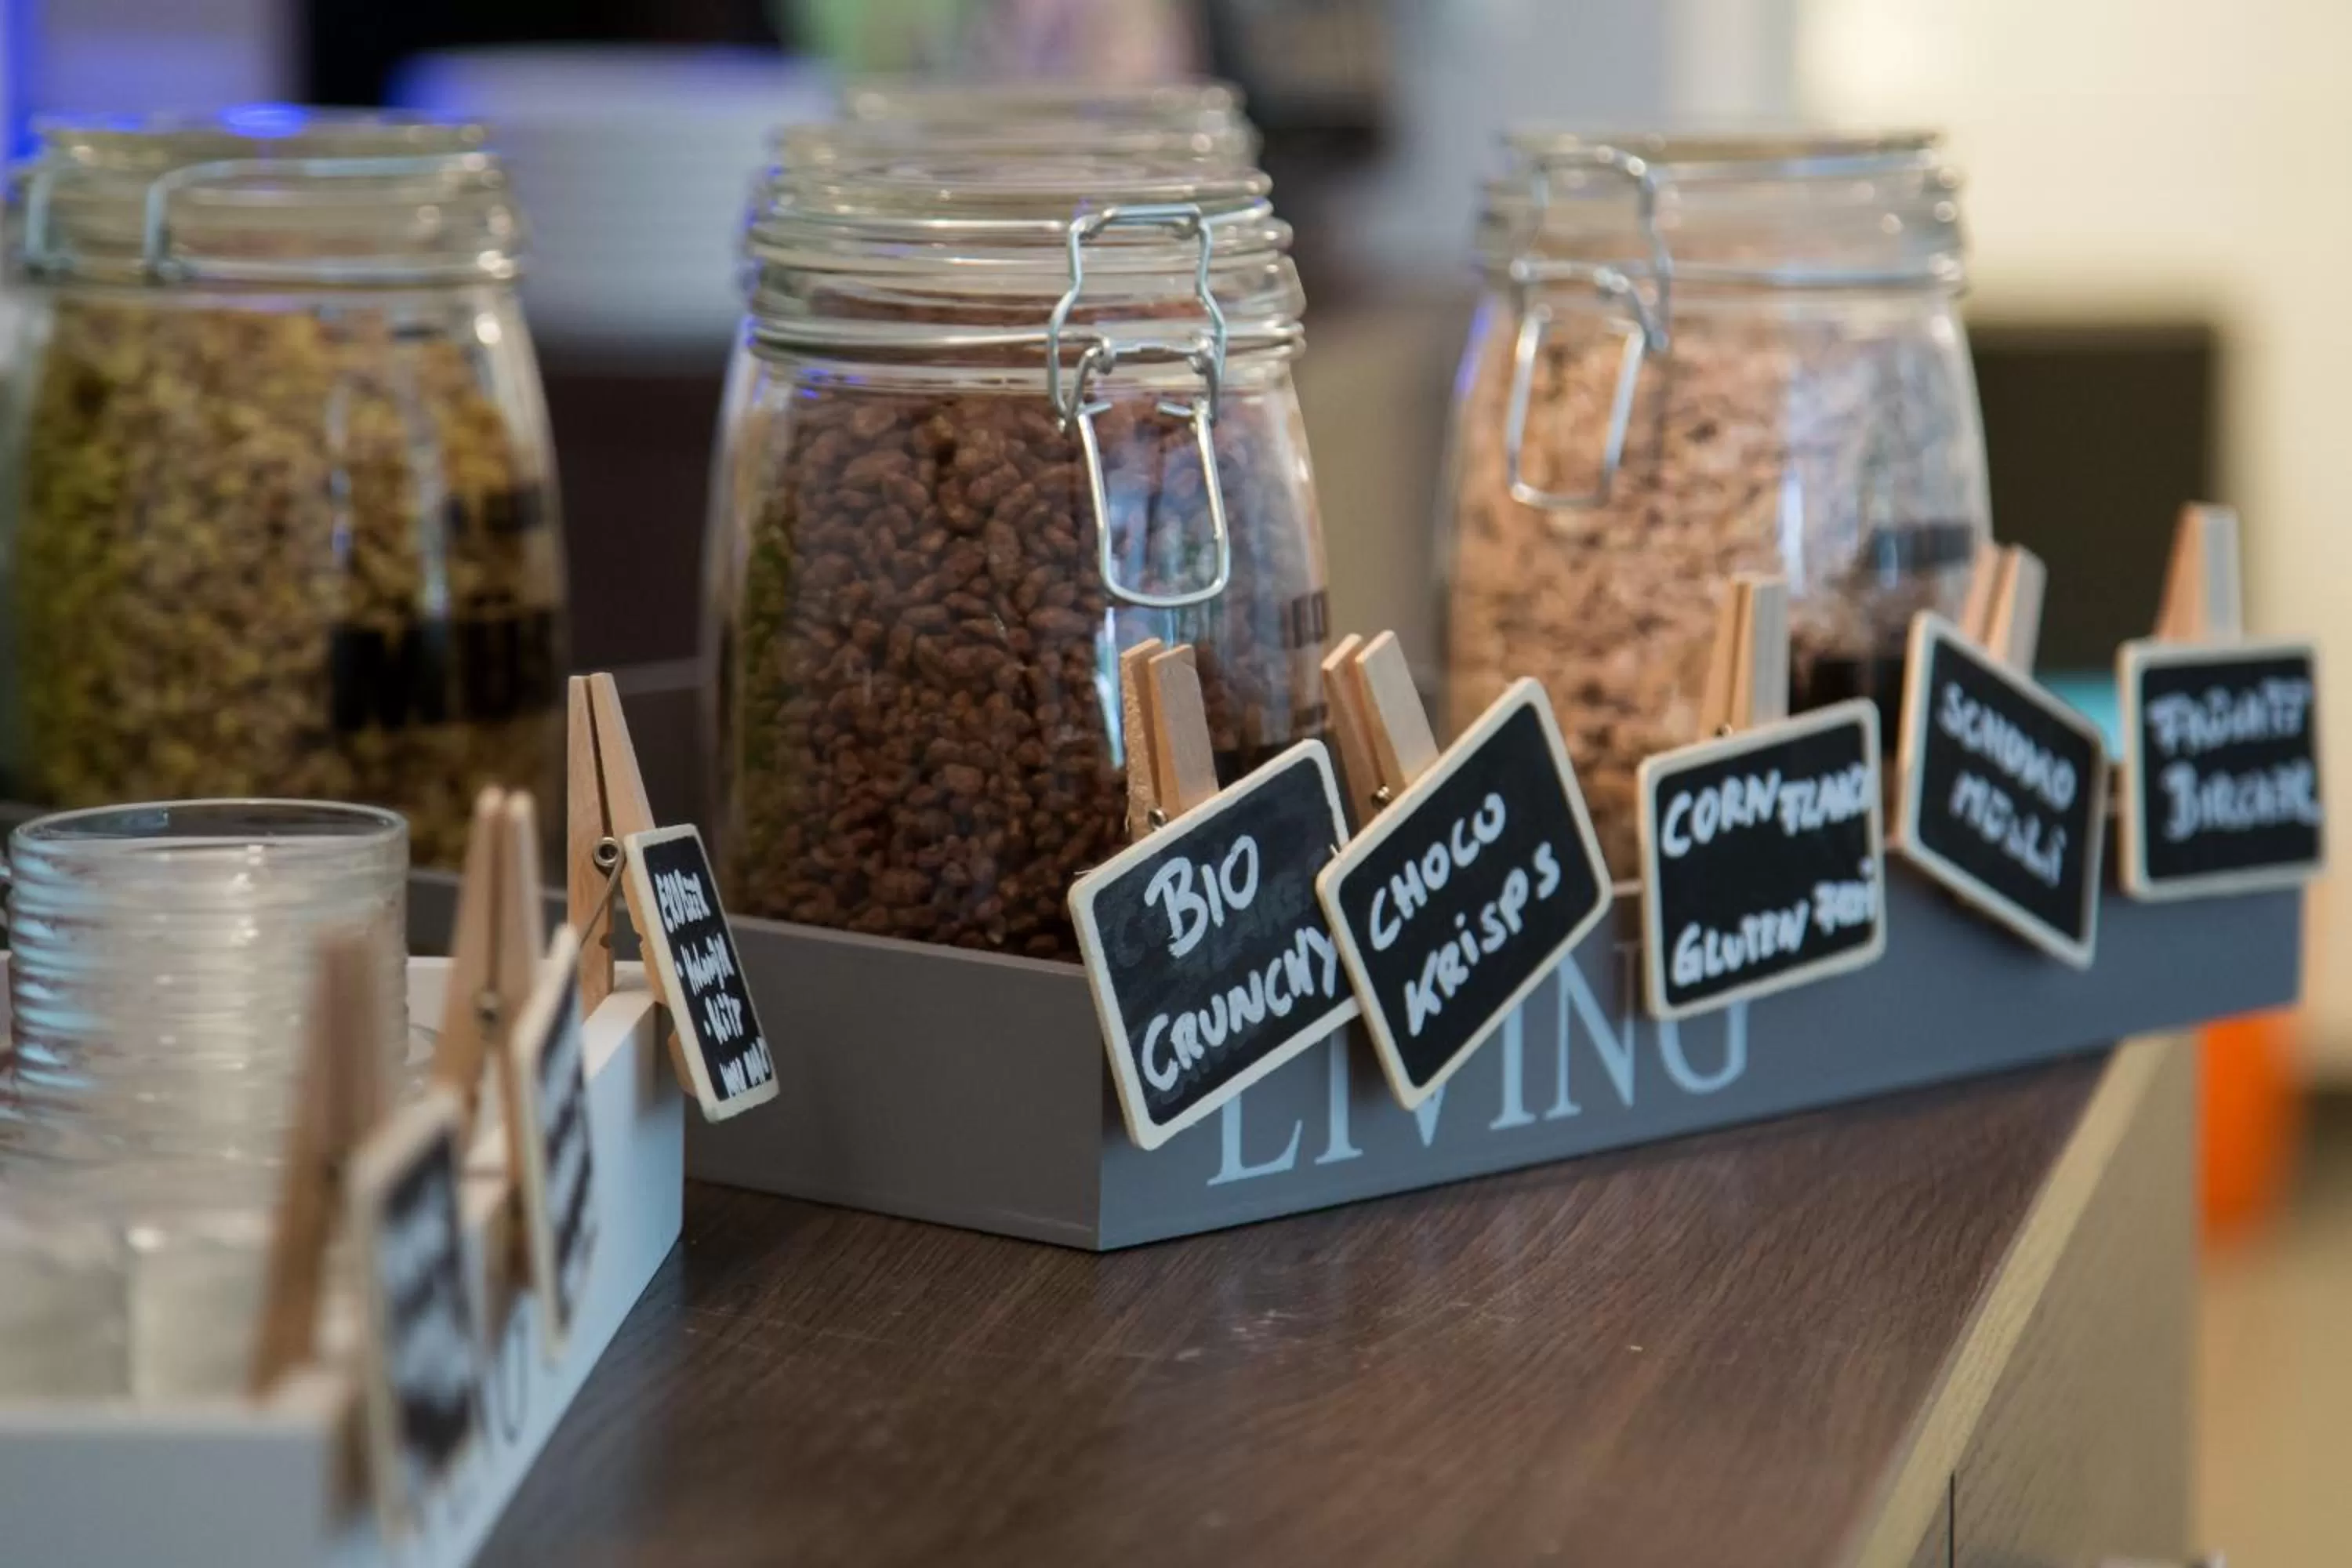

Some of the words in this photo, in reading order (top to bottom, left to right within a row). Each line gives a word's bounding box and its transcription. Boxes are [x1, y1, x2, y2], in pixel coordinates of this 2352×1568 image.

[1144, 835, 1258, 958] BIO
[1369, 793, 1506, 951] CHOCO
[1142, 927, 1338, 1091] CRUNCHY
[1671, 901, 1809, 987] GLUTEN
